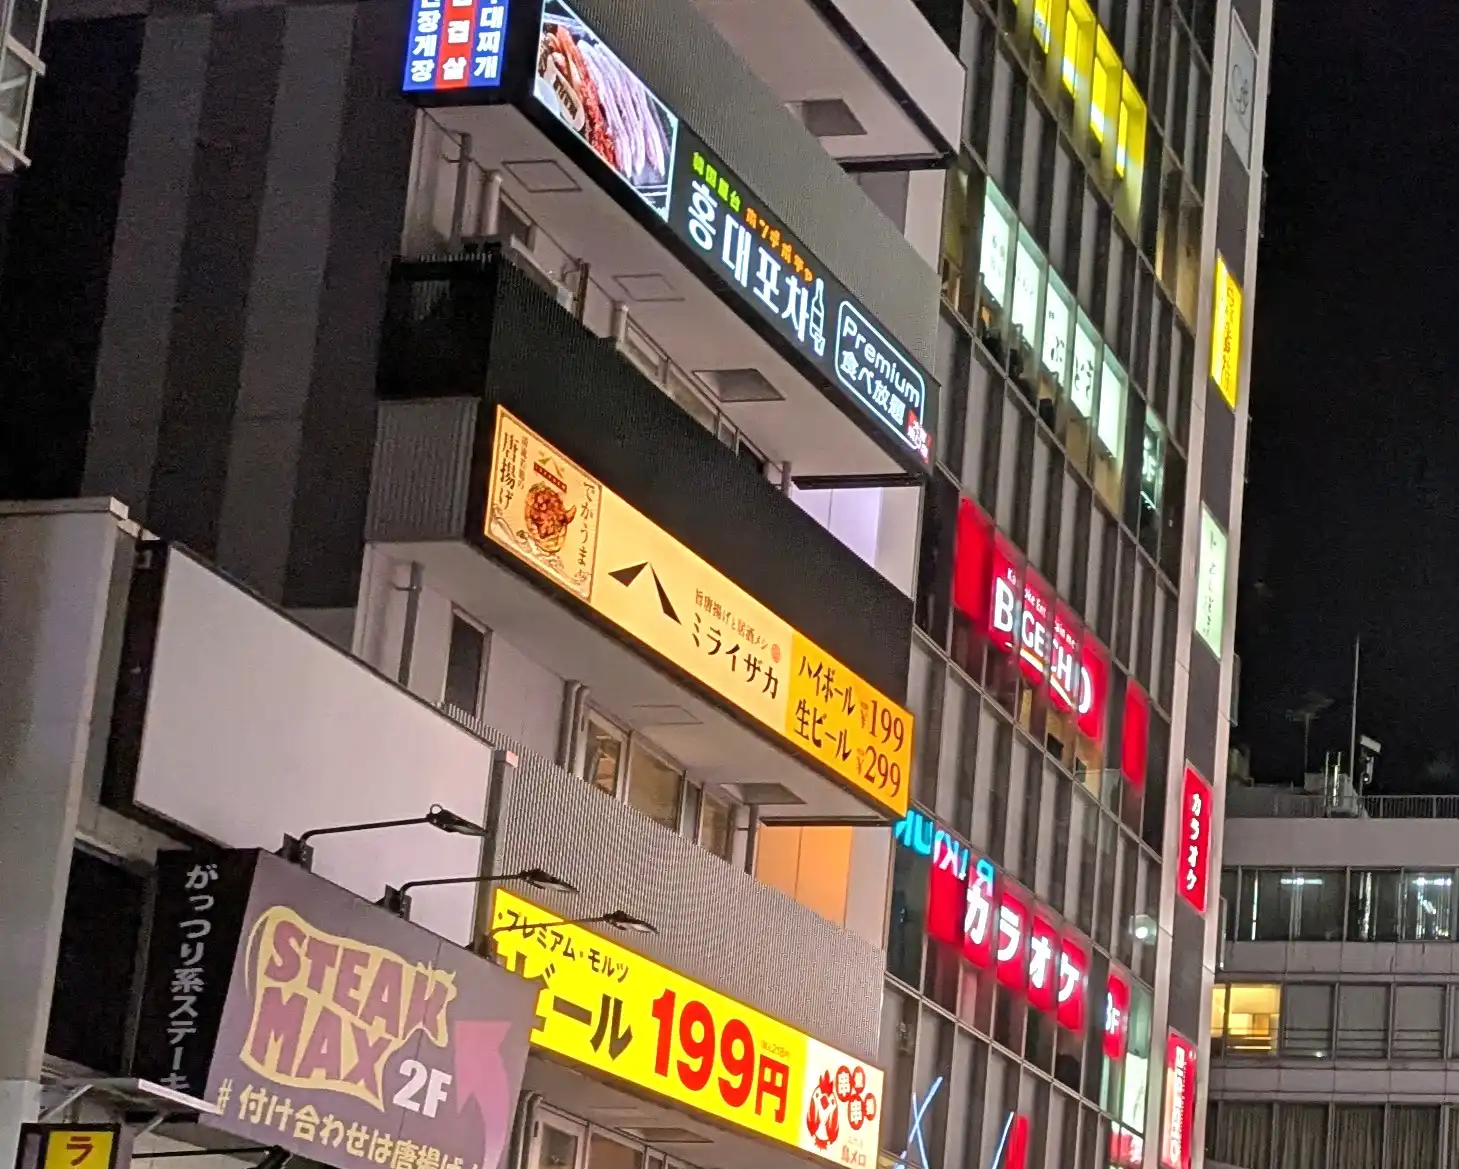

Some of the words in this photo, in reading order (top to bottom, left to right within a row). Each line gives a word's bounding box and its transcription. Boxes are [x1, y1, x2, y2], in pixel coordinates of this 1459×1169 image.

[474, 0, 504, 78] 대찌개
[843, 316, 919, 407] Premium
[692, 612, 778, 699] ミライザカ
[798, 656, 855, 715] ハイボール
[794, 699, 852, 762] 生ビール
[1185, 794, 1202, 891] カラオケ
[160, 863, 219, 1093] がっつり系ステーキ
[266, 919, 454, 1044] STEAK
[965, 884, 1080, 1003] カラオケ
[253, 987, 396, 1101] MAX
[393, 1059, 453, 1118] 2F
[652, 989, 789, 1124] 199円
